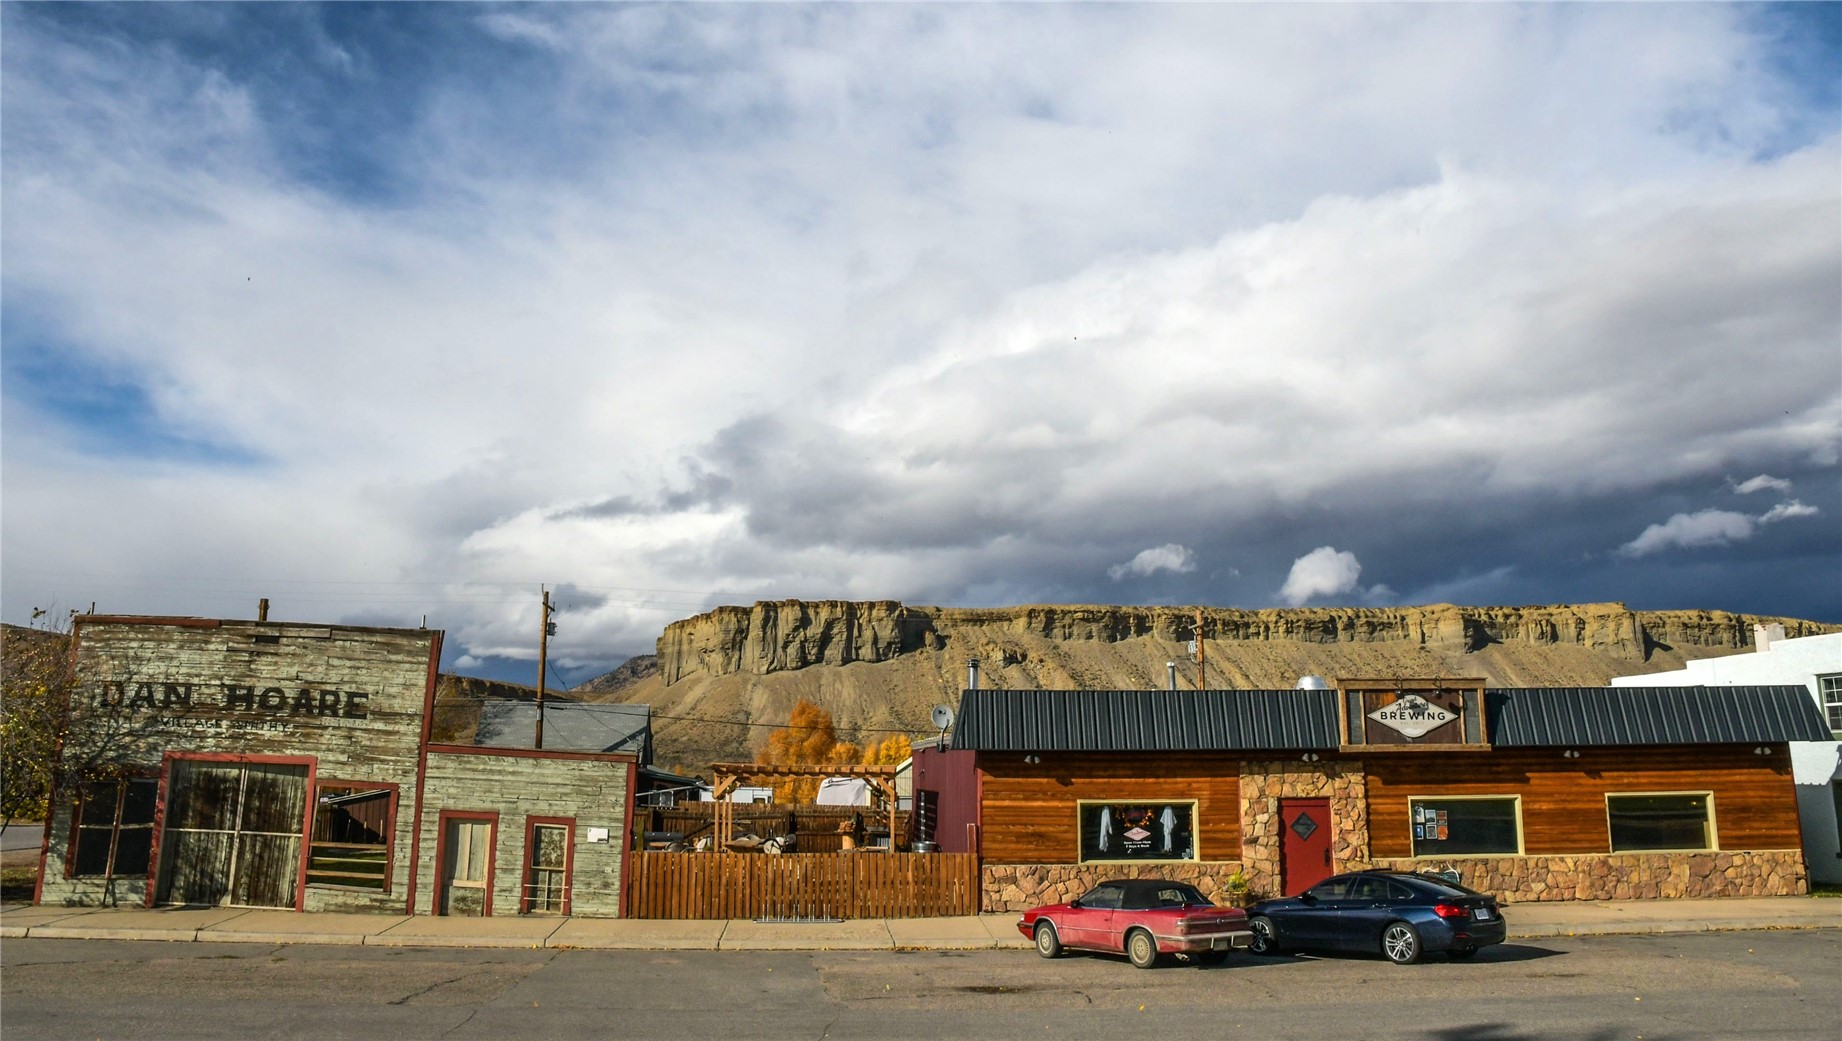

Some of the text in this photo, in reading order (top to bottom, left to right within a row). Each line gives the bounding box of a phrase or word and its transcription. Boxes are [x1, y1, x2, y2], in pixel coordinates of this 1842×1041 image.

[99, 681, 368, 719] DAN HOARE
[1380, 712, 1446, 720] BREWING
